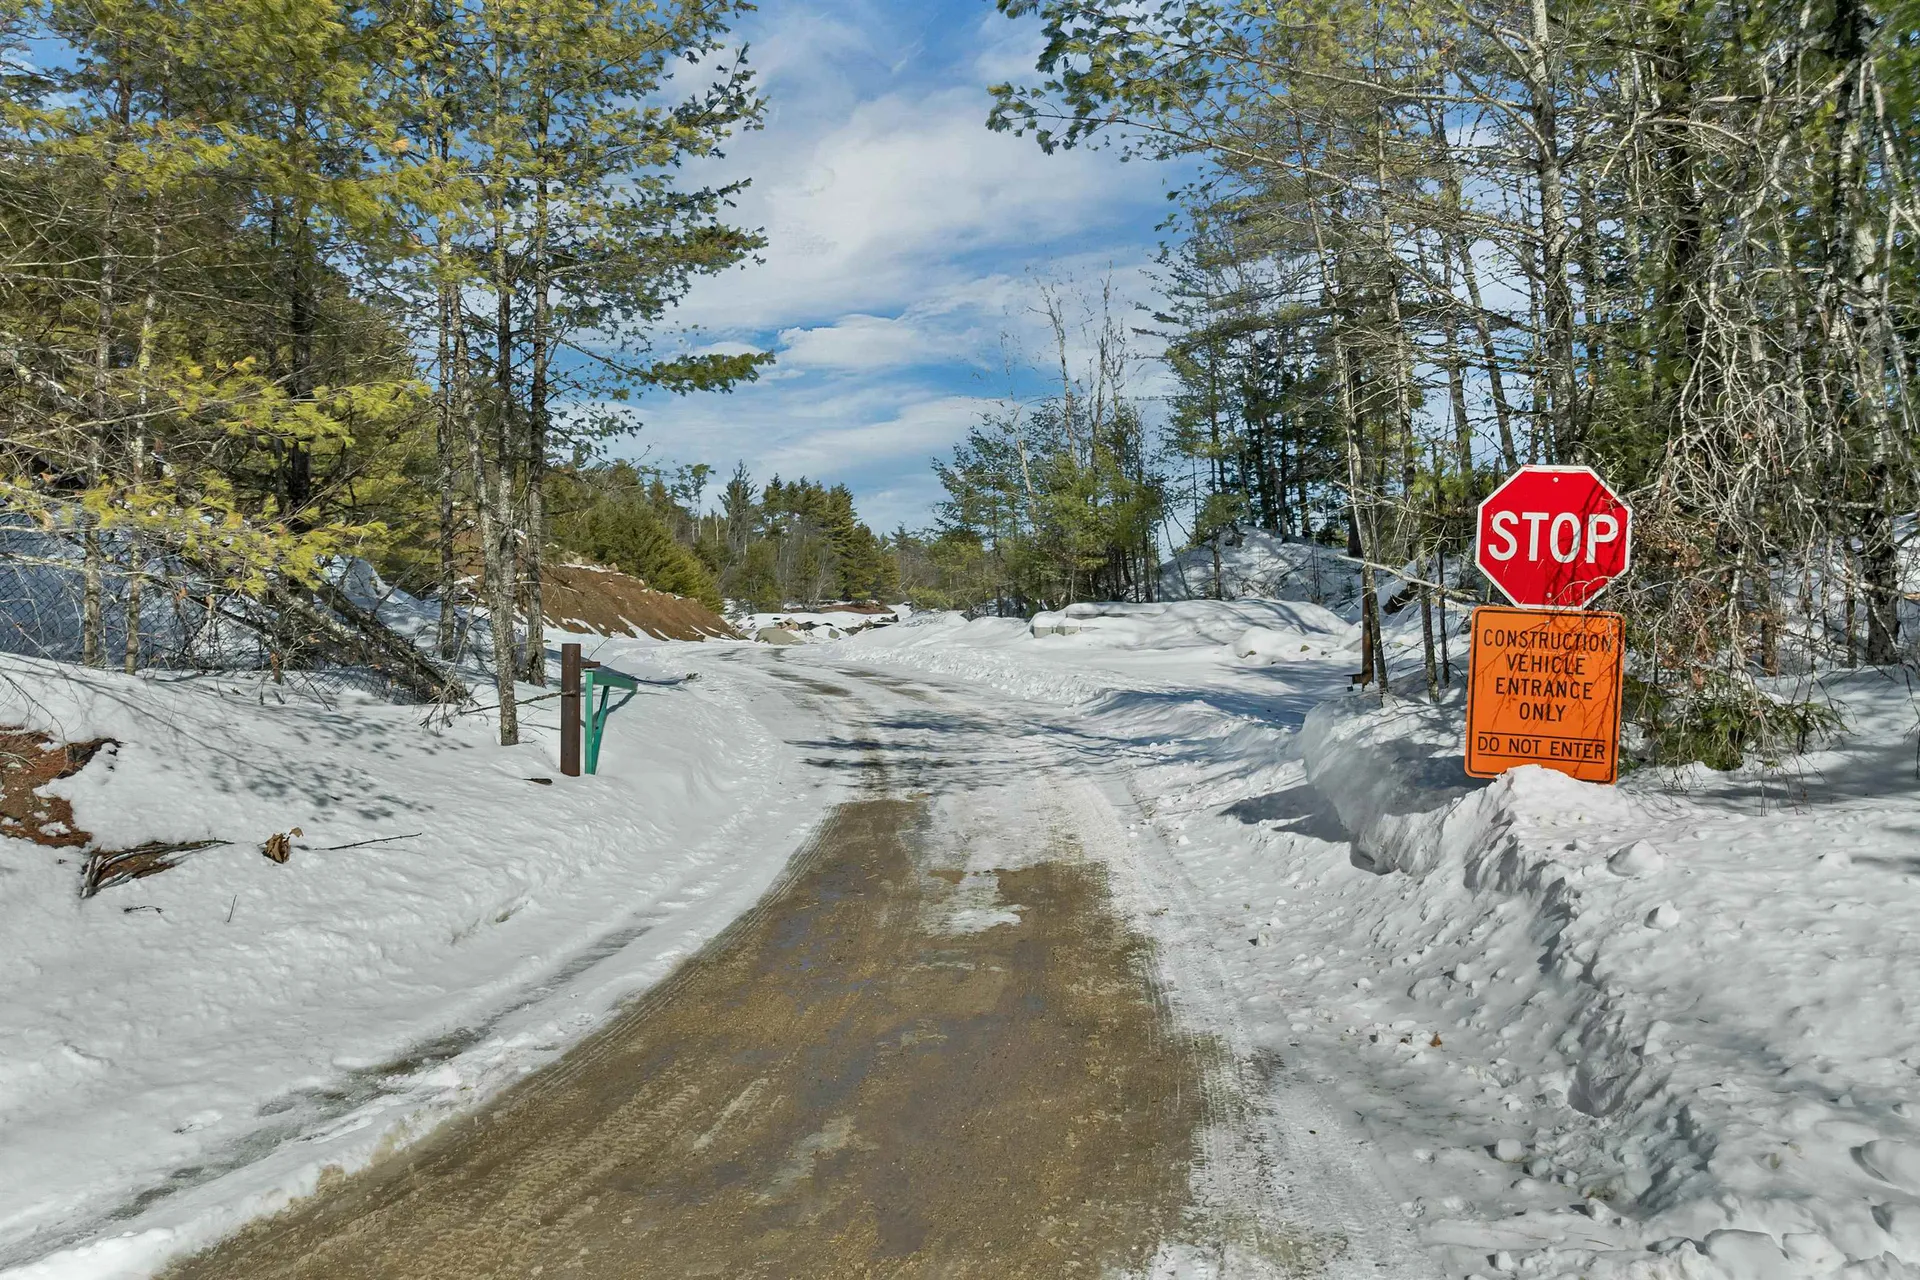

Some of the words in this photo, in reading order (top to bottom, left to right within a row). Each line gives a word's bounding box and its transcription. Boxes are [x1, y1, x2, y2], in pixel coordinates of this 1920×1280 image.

[1487, 510, 1619, 564] STOP
[1483, 628, 1612, 653] CONSTRUCTION
[1506, 653, 1586, 675] VEHICLE
[1495, 677, 1593, 700] ENTRANCE
[1519, 702, 1567, 722] ONLY
[1477, 736, 1500, 752] DO
[1508, 738, 1541, 755] NOT
[1550, 742, 1606, 760] ENTER
